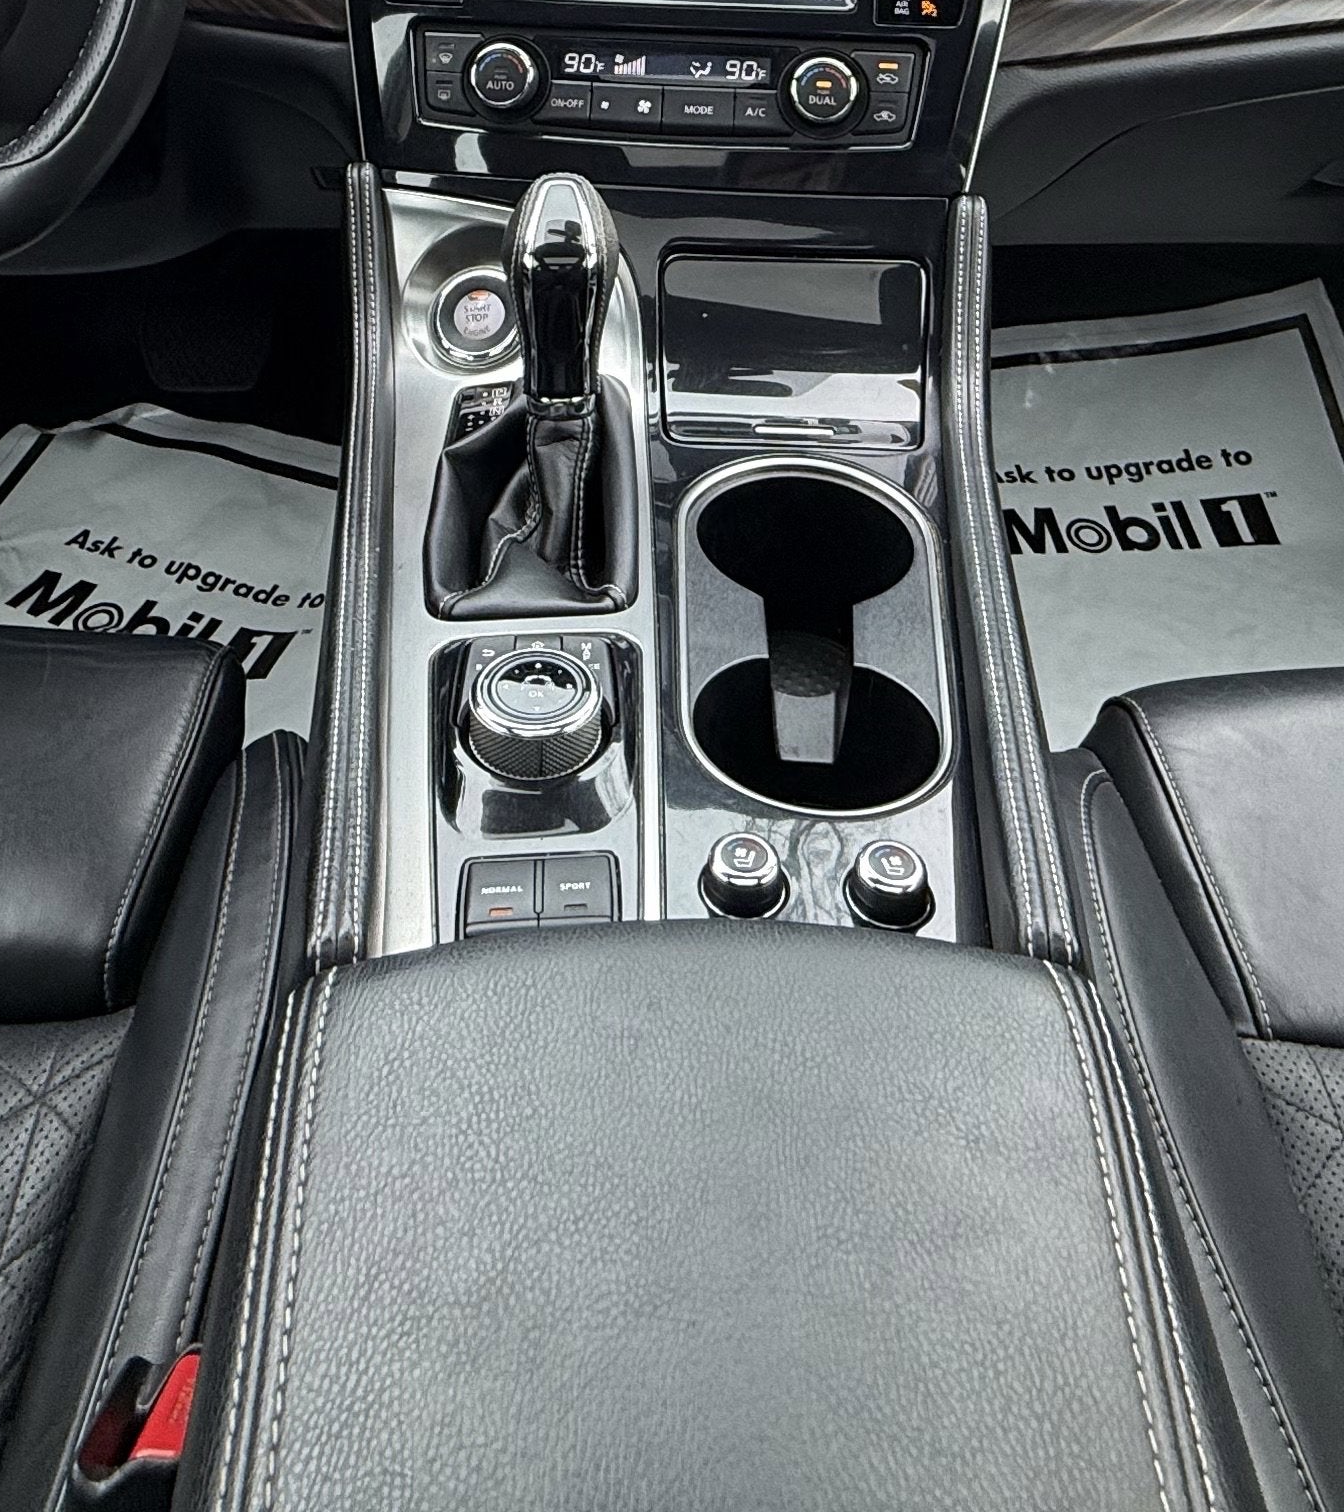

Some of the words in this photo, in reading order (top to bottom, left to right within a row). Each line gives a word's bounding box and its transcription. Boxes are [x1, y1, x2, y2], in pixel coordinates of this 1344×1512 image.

[893, 7, 910, 15] BAG
[486, 80, 515, 91] AUTO
[808, 94, 838, 106] DUAL
[683, 104, 714, 116] MODE
[744, 105, 766, 118] A/C
[463, 302, 492, 313] START
[465, 313, 489, 323] STOP
[463, 326, 491, 337] ENGINE
[1045, 461, 1077, 483] to
[1085, 447, 1214, 486] upgrade
[1221, 445, 1254, 470] to
[1002, 499, 1202, 556] Mobil
[64, 528, 124, 561] Ask
[126, 546, 158, 570] to
[163, 559, 292, 610] upgrade
[297, 589, 327, 612] to
[527, 690, 545, 698] OK
[480, 885, 524, 896] NORMAL
[559, 881, 592, 892] SPORT
